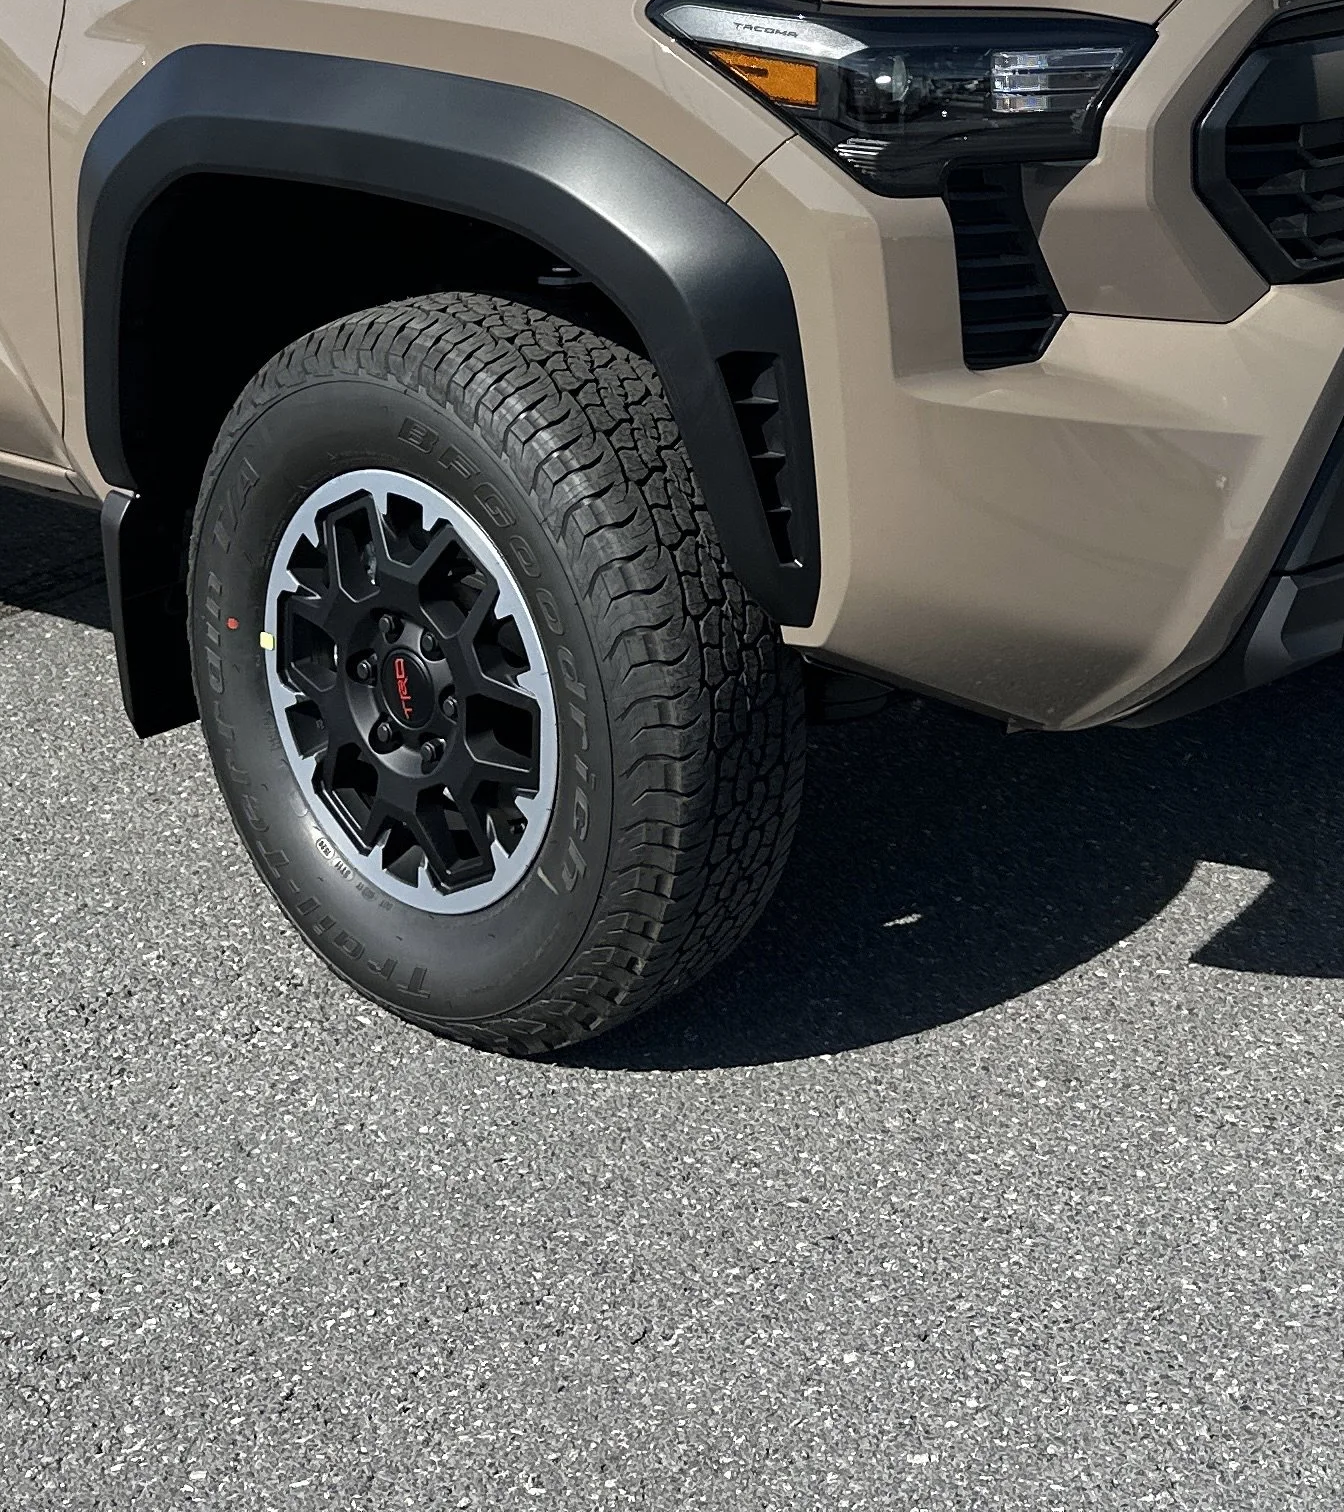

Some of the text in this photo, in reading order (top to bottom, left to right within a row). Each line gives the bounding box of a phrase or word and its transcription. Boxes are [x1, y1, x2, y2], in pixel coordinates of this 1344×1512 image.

[733, 21, 798, 38] TACOMA
[396, 416, 597, 894] BFGoodrich
[395, 658, 413, 720] TRD
